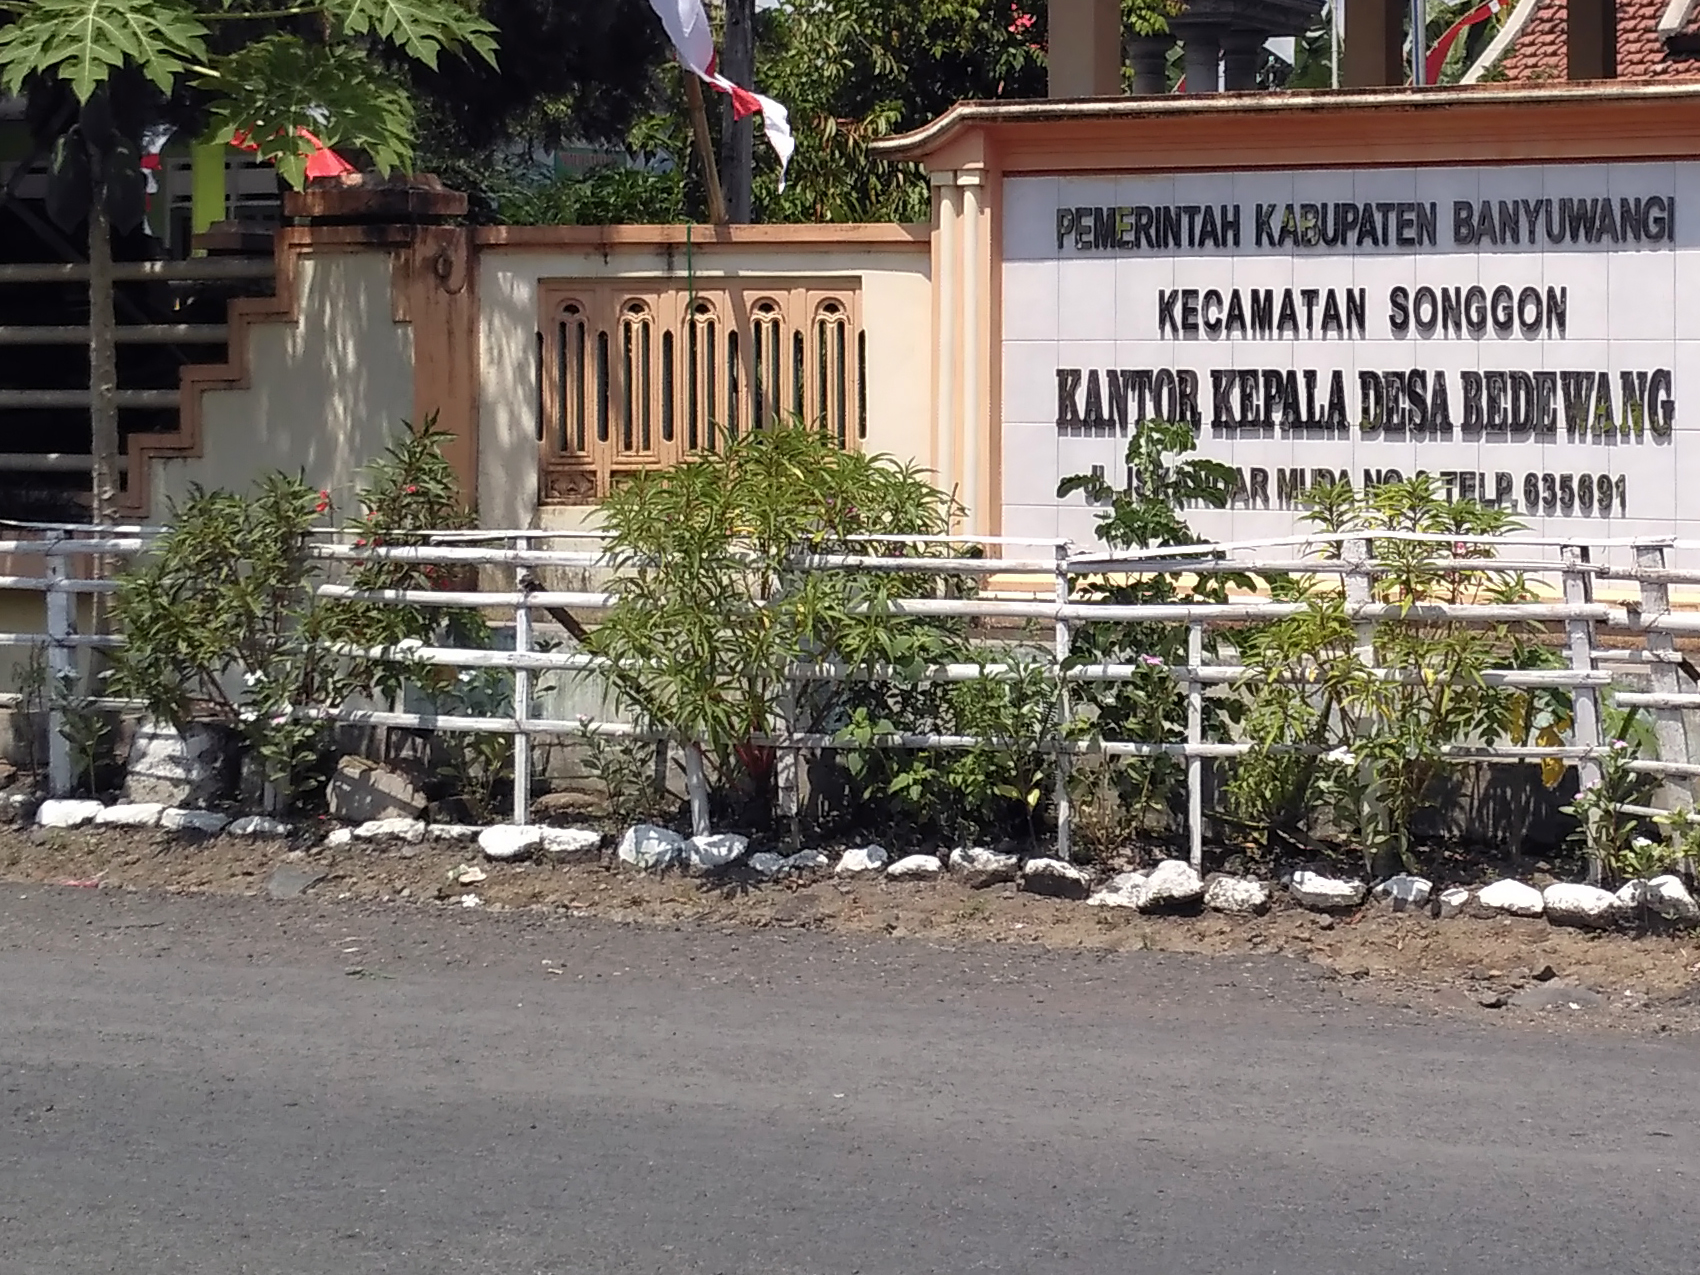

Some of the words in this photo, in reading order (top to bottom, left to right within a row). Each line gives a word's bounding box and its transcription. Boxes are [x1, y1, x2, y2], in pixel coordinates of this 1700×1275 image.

[1056, 204, 1240, 251] PEMERINTAH
[1255, 201, 1437, 247] KABUPATEN
[1453, 195, 1676, 244] BANYUWANGI
[1158, 287, 1367, 338] KECAMATAN
[1389, 285, 1568, 337] SONGGON
[1056, 367, 1202, 429] KANTOR
[1210, 368, 1350, 431] KEPALA
[1359, 369, 1454, 434] DESA
[1461, 368, 1675, 440] BEDEWANG
[1523, 473, 1627, 517] 635691
